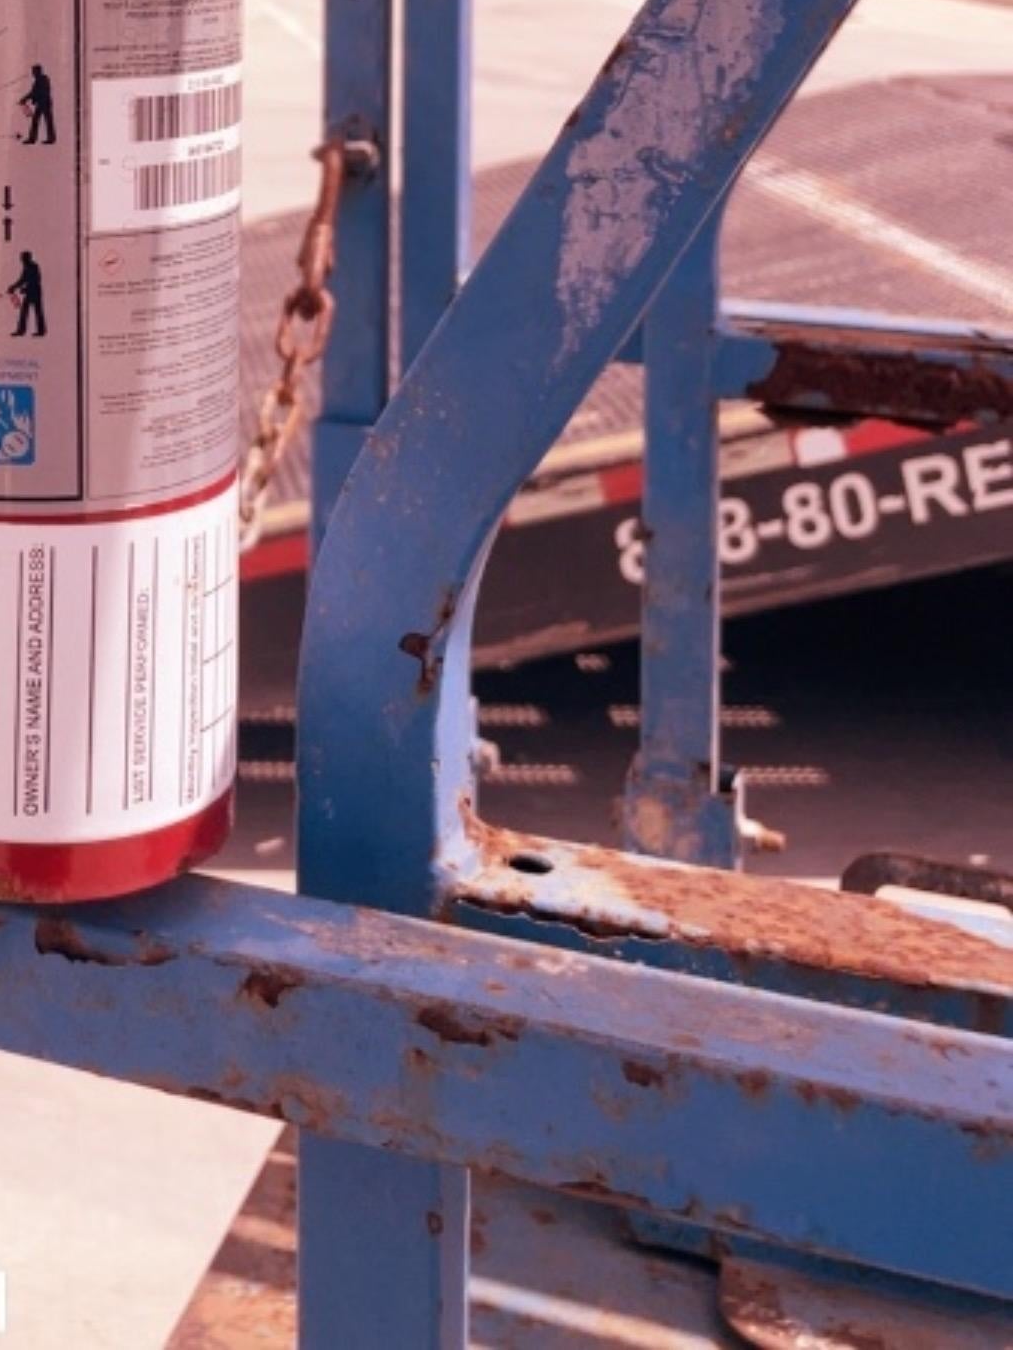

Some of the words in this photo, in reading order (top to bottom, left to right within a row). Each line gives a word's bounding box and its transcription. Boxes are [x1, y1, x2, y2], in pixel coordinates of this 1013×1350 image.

[614, 439, 1013, 585] 88-80-RE
[27, 542, 46, 634] ADDRESS:
[27, 634, 44, 675] AND
[25, 677, 43, 730] NAME
[133, 697, 148, 768] SERVICE
